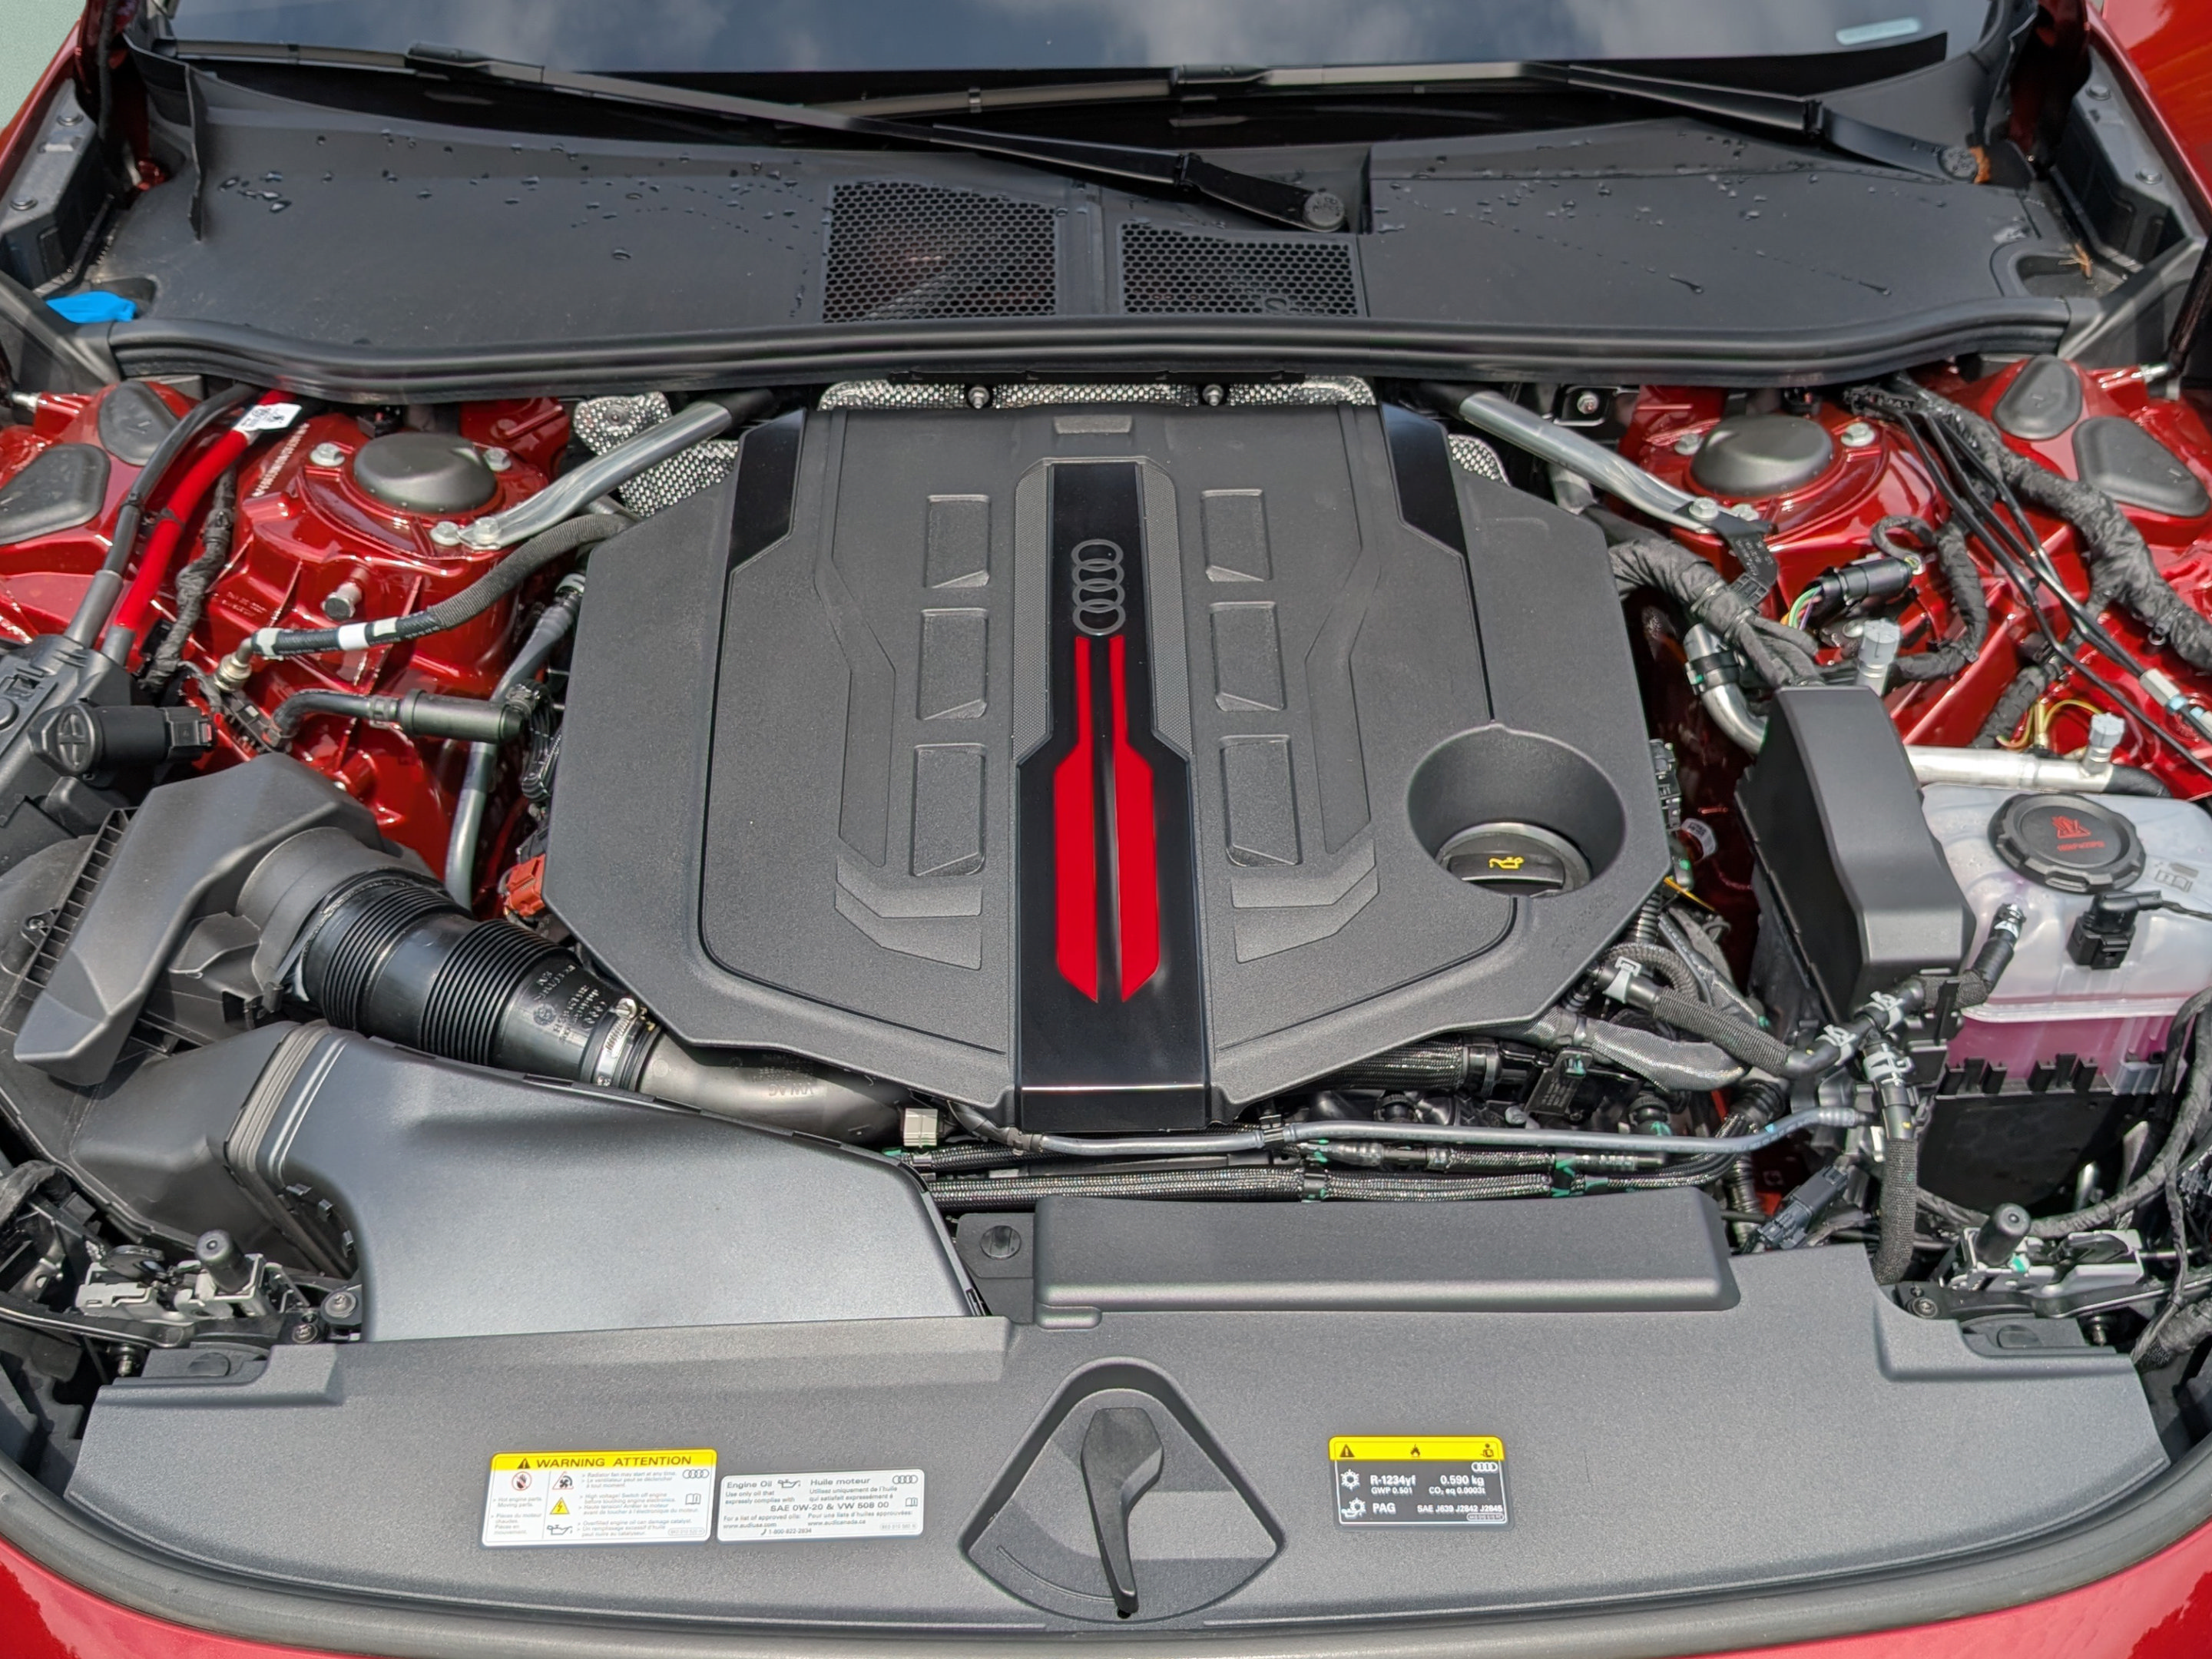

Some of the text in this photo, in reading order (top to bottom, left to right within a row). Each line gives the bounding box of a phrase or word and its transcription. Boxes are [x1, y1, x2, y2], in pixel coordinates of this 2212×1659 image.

[537, 1456, 691, 1468] WARNING ATTENTION
[727, 1481, 757, 1489] Engine
[1370, 1475, 1416, 1486] R-1234yf
[1440, 1475, 1485, 1486] 0.590 kg
[1371, 1486, 1412, 1495] GWP 0.501
[1456, 1486, 1486, 1495] 0.0003t
[793, 1503, 823, 1512] 0W-20
[1373, 1502, 1396, 1513] PAG
[1417, 1504, 1503, 1513] SAE J639 J2842 J2845
